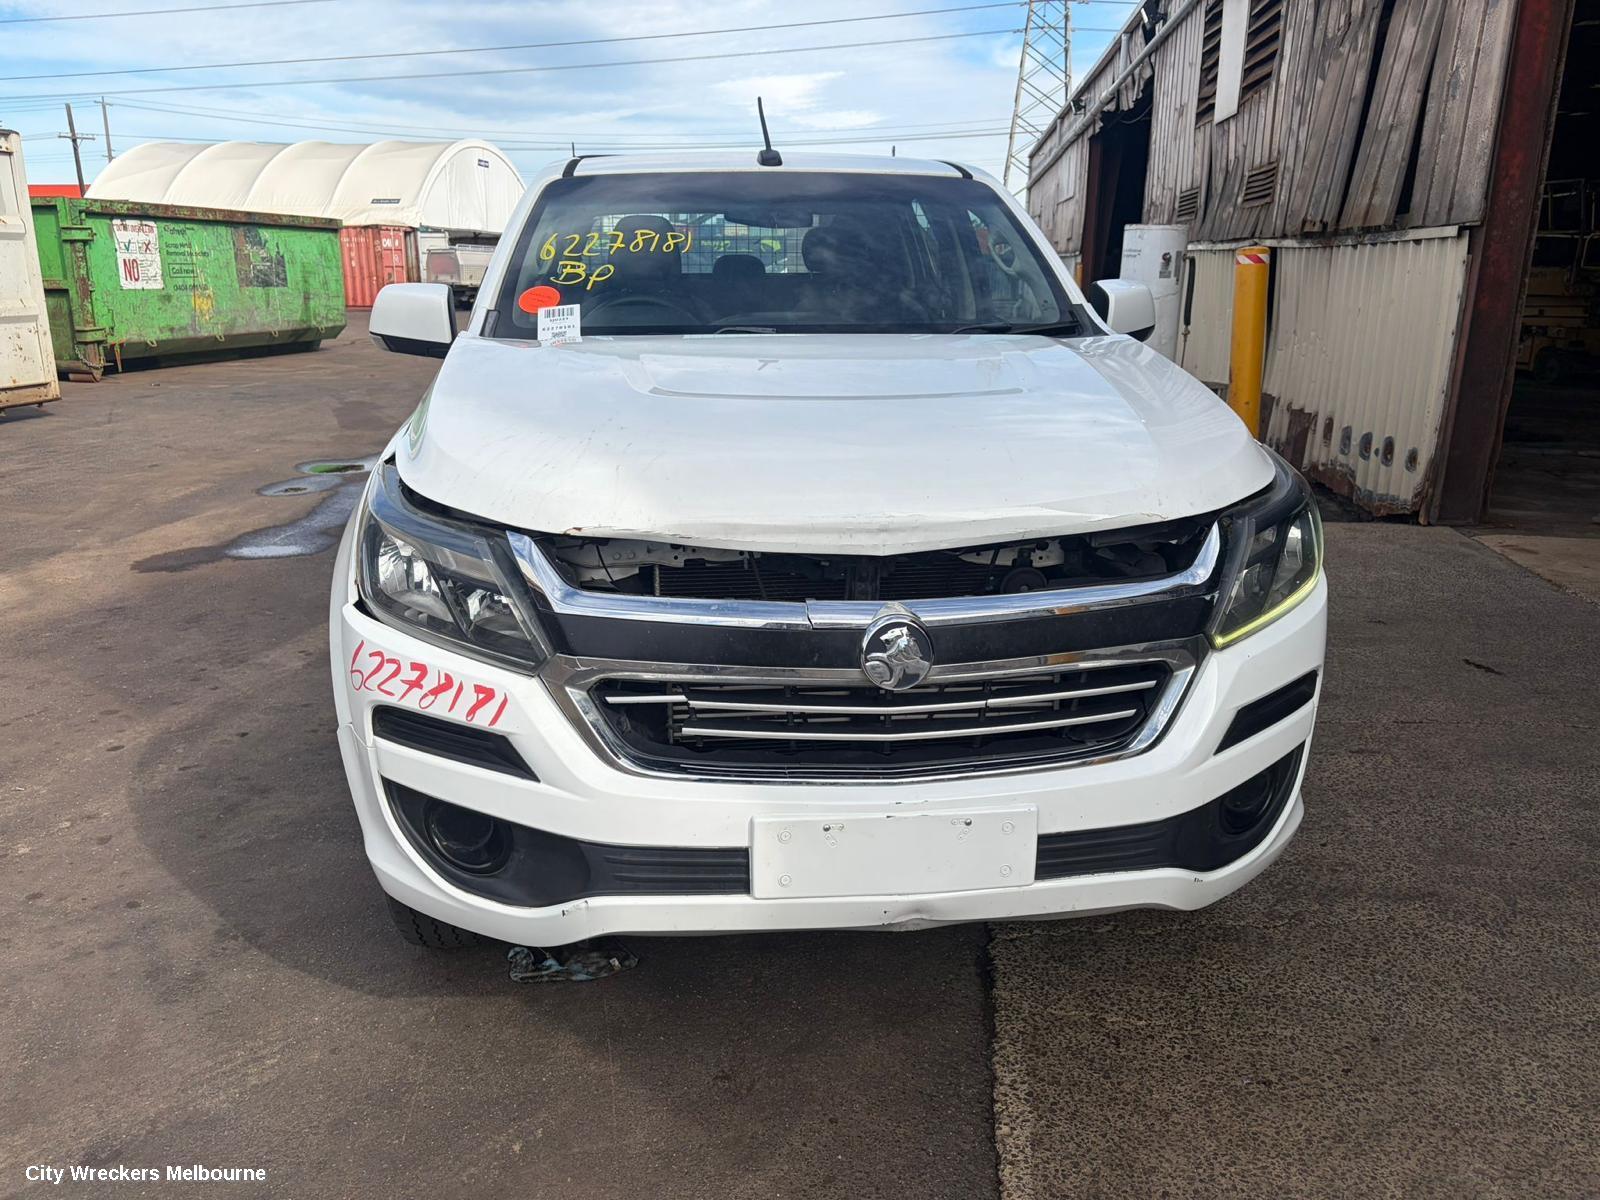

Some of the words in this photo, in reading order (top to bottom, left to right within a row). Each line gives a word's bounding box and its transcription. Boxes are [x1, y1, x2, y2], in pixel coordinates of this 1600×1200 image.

[540, 229, 692, 260] 62278181
[123, 259, 140, 281] NO
[350, 639, 509, 727] 62278181
